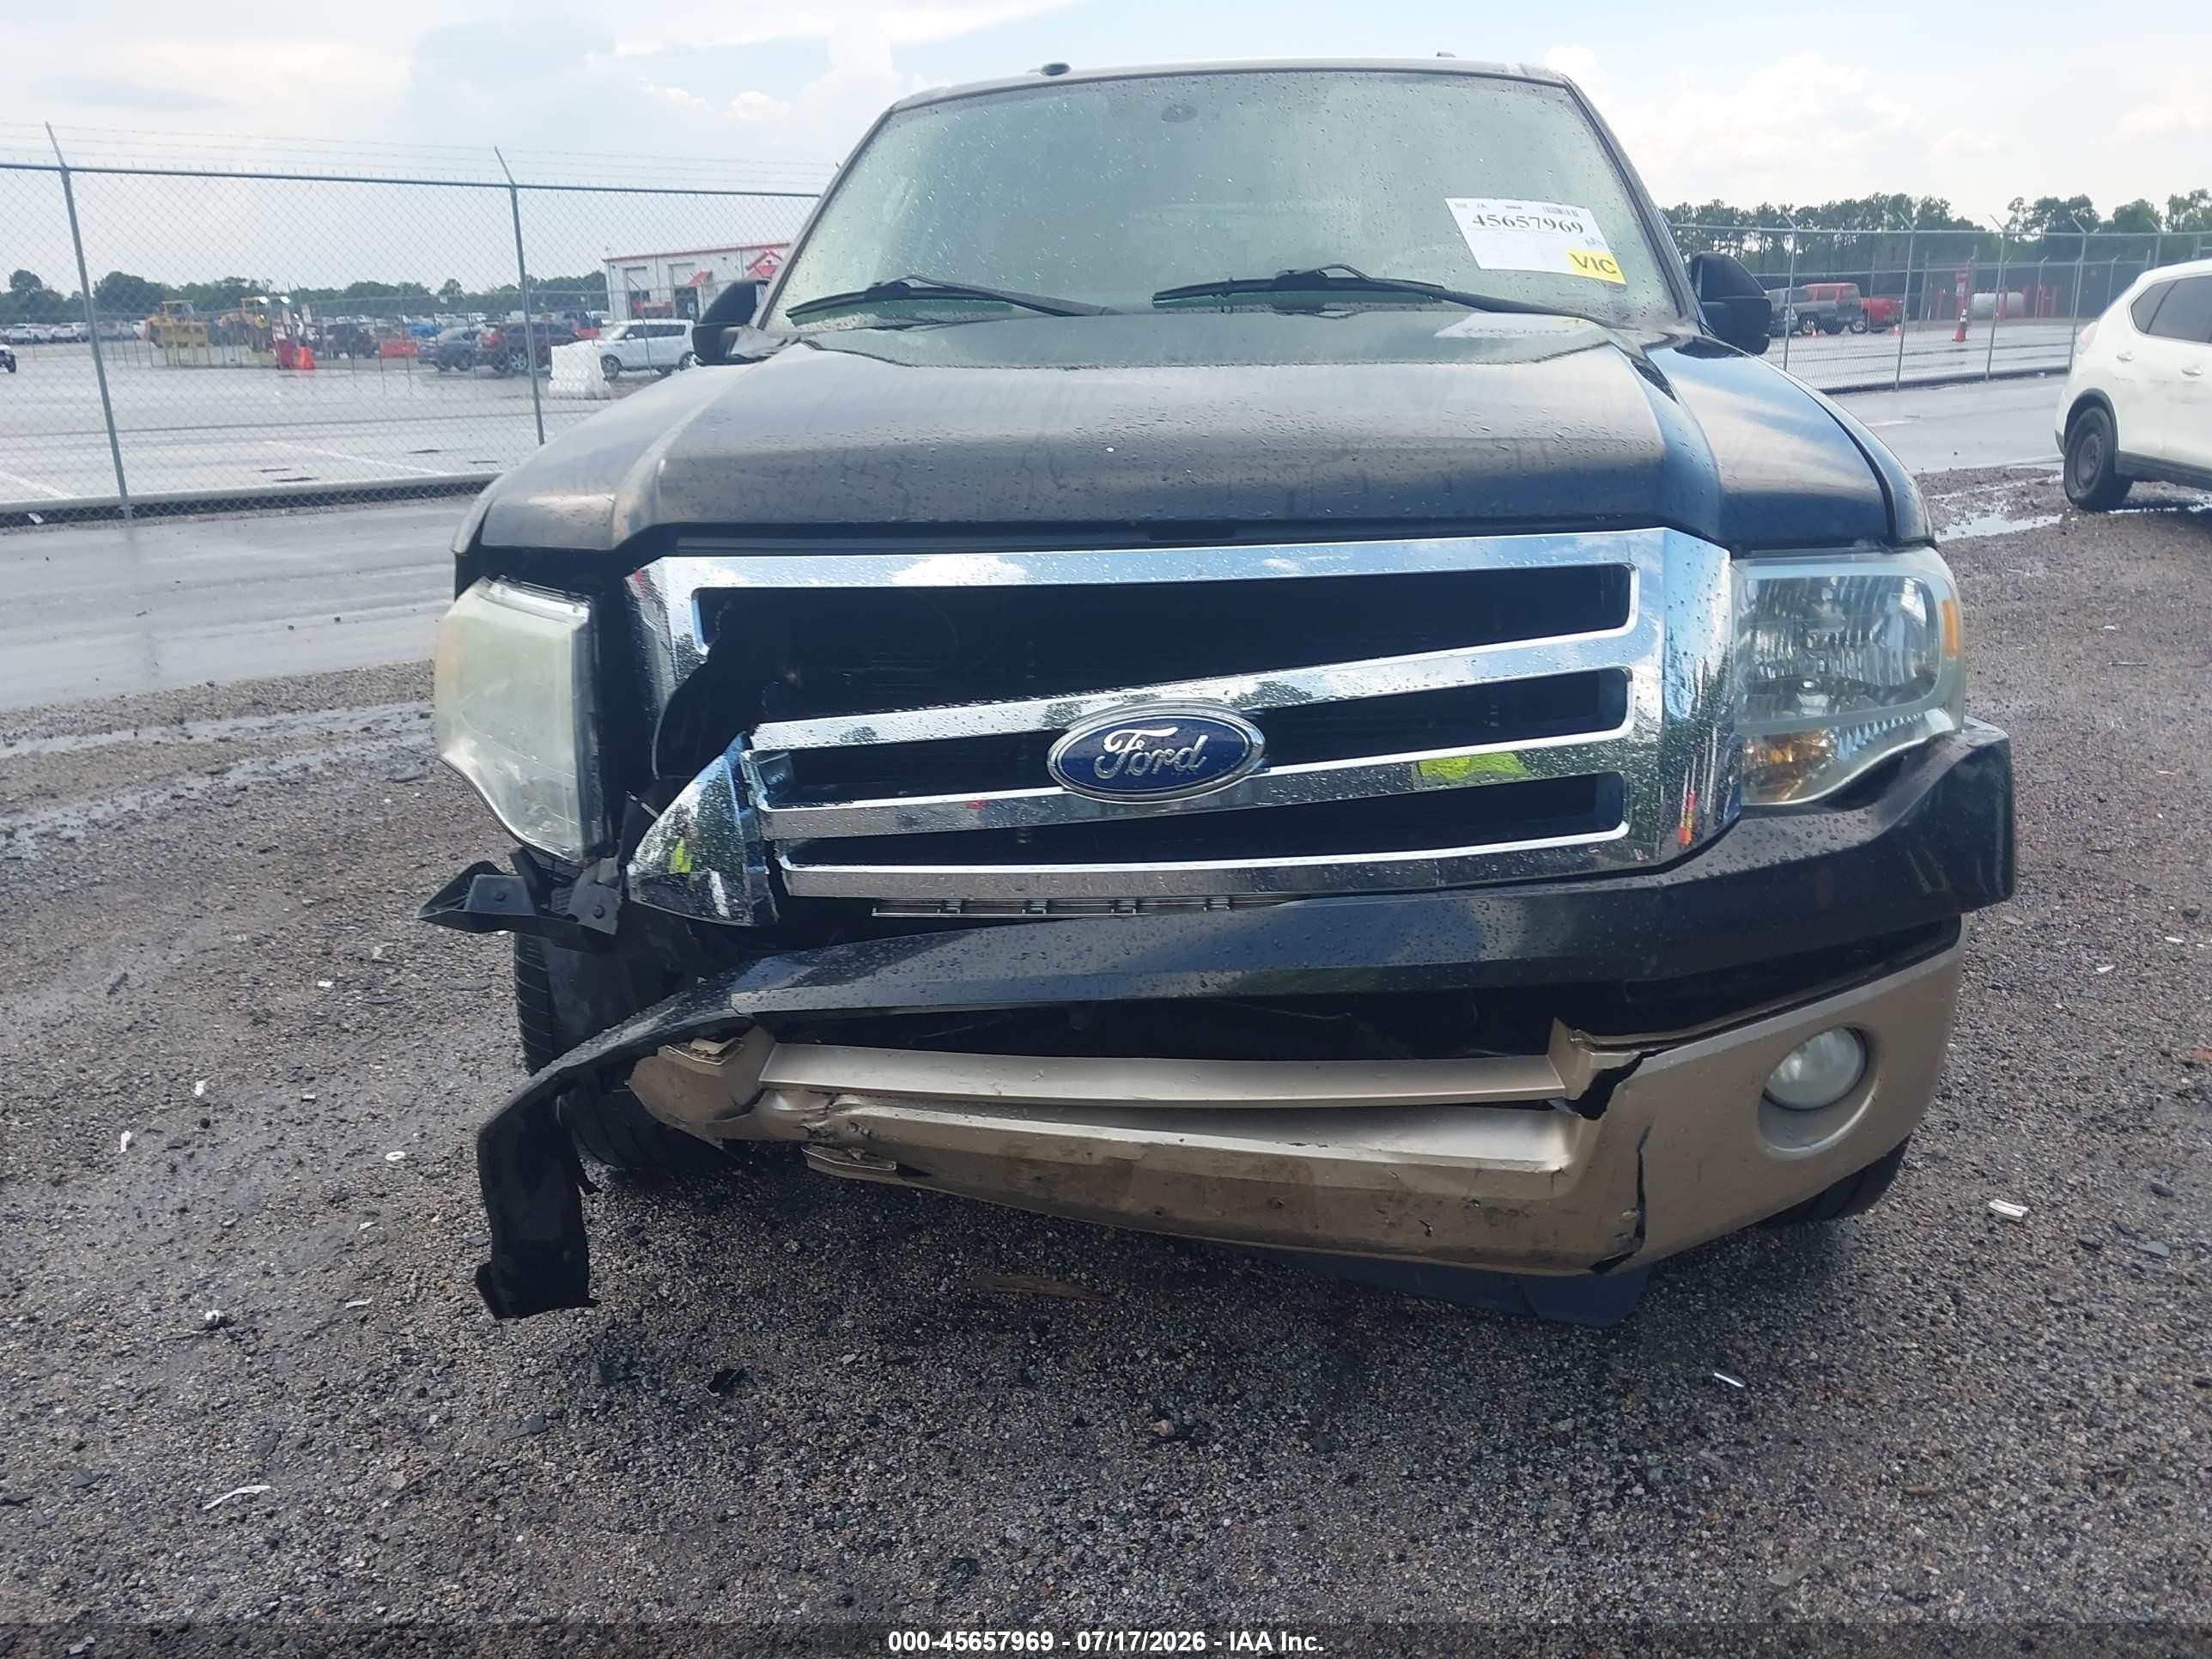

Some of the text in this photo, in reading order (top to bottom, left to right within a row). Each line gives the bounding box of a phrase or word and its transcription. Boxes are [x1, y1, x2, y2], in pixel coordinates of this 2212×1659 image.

[1472, 213, 1584, 234] 45657969
[1569, 252, 1618, 275] VIC
[1092, 726, 1209, 780] Ford
